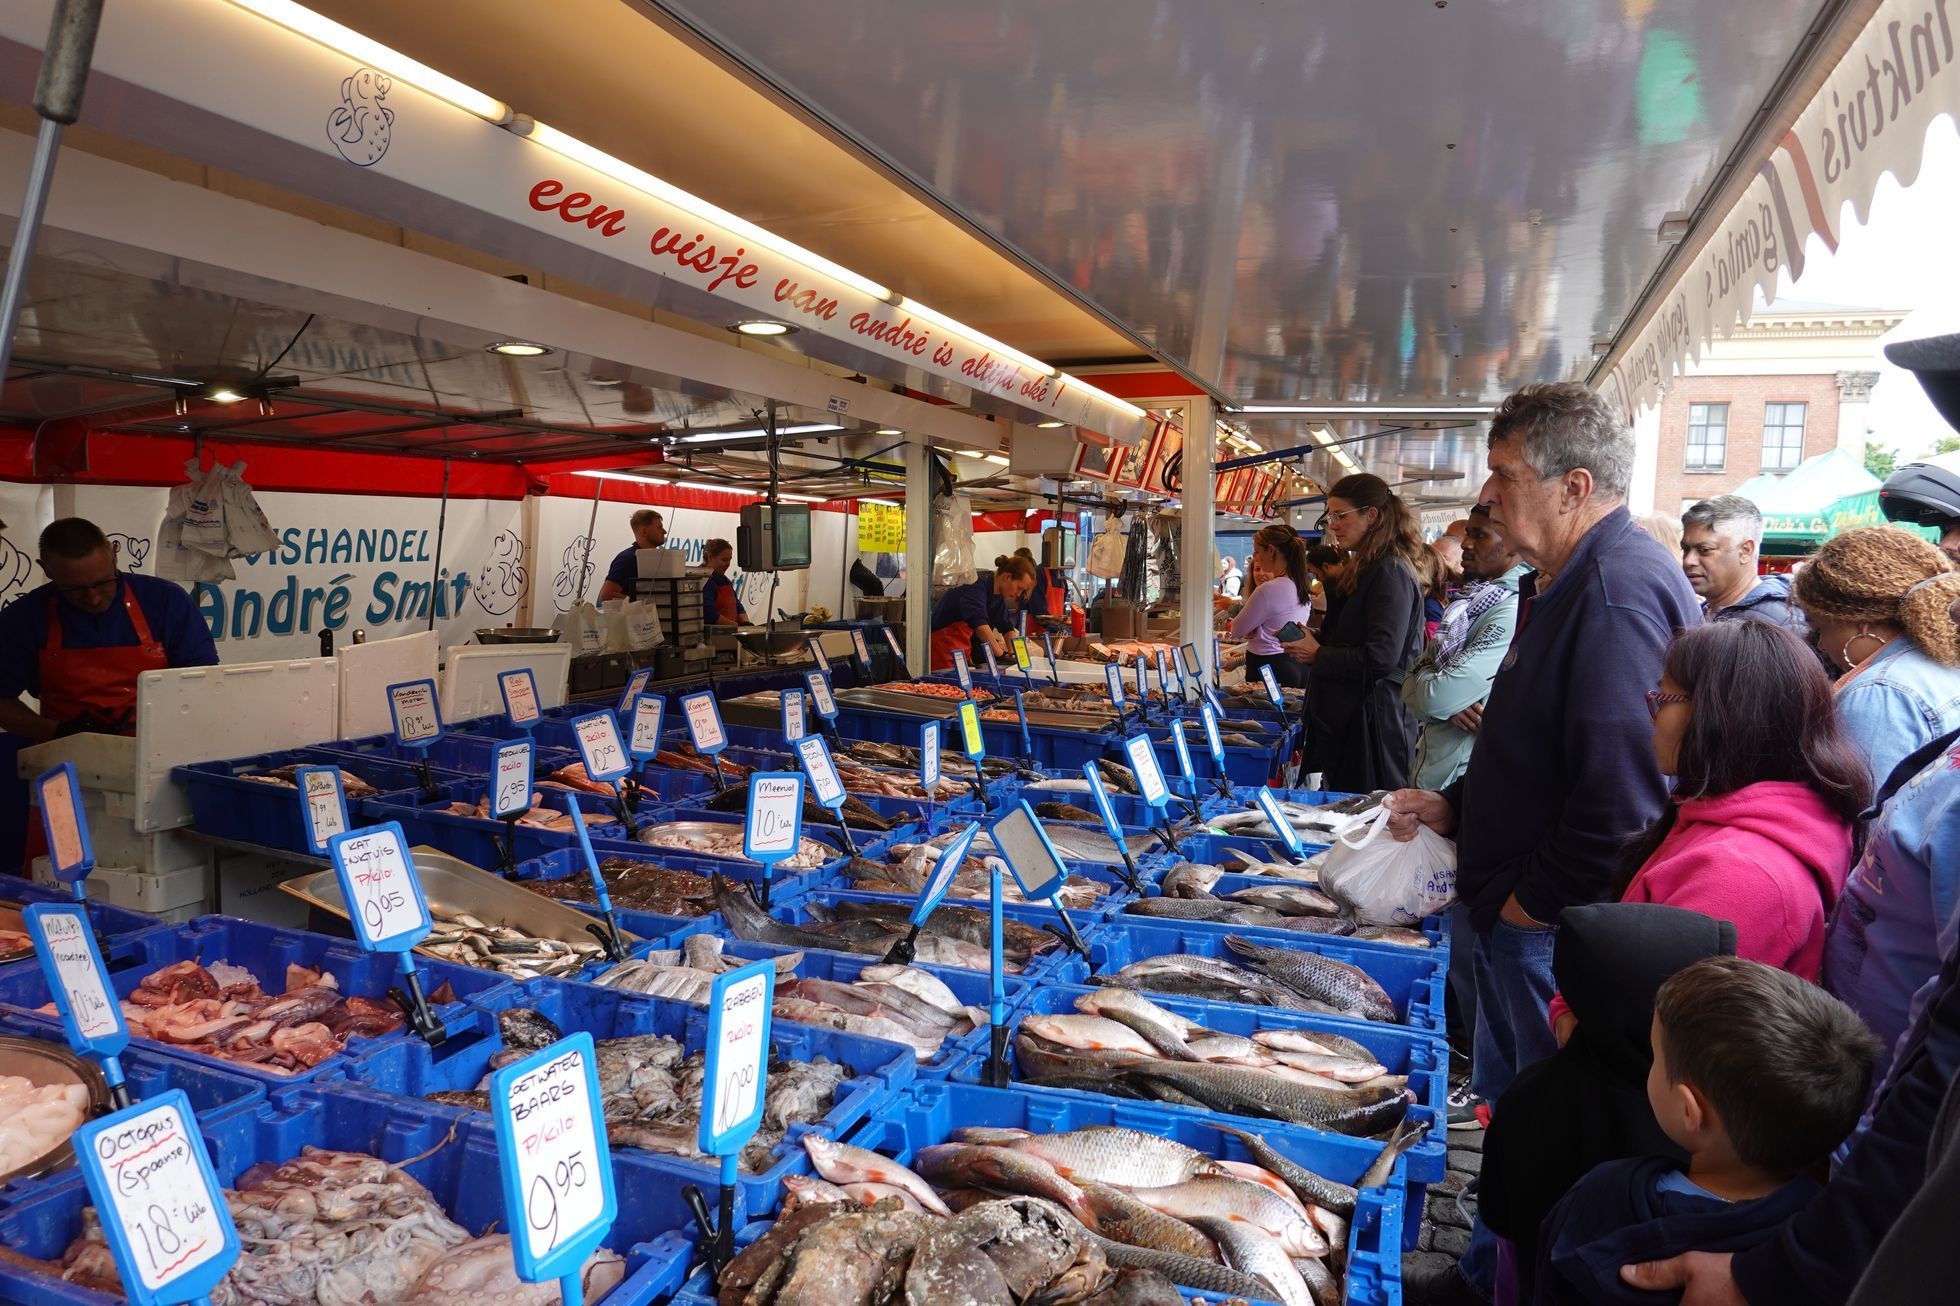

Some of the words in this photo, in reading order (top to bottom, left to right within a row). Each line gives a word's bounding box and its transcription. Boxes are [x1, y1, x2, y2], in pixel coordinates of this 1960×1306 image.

[528, 179, 627, 238] een
[650, 226, 760, 293] visje
[773, 278, 838, 322] van
[849, 316, 928, 357] andré
[932, 340, 954, 368] is
[960, 357, 1015, 393] altijd
[1020, 377, 1049, 403] oké
[196, 572, 357, 643] André
[365, 567, 472, 628] Smit
[348, 838, 371, 851] KAT
[510, 1079, 576, 1122] BAARS
